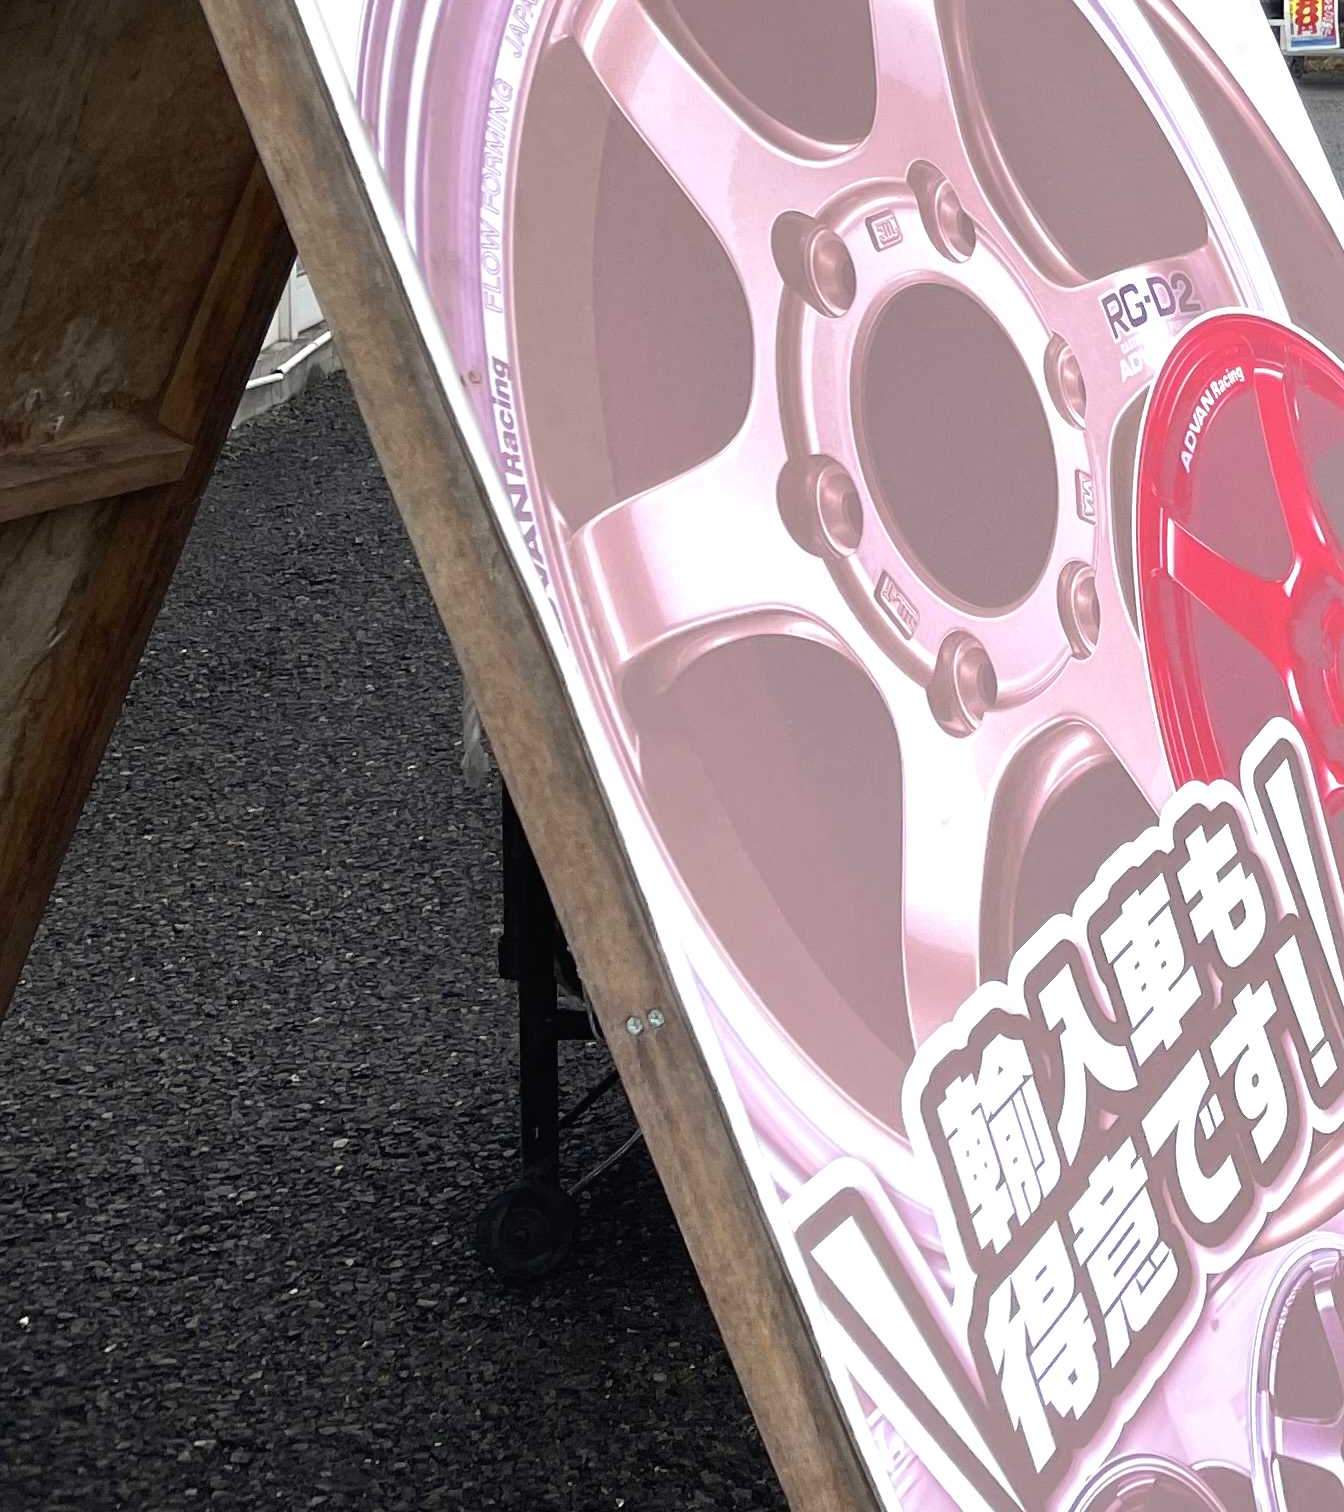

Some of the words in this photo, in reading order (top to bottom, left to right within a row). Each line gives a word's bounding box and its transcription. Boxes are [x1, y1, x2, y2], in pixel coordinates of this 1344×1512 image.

[491, 356, 523, 478] Racing
[1180, 392, 1215, 474] ADVAN
[1210, 365, 1246, 399] Racing
[935, 809, 1271, 1253] 輸入車も
